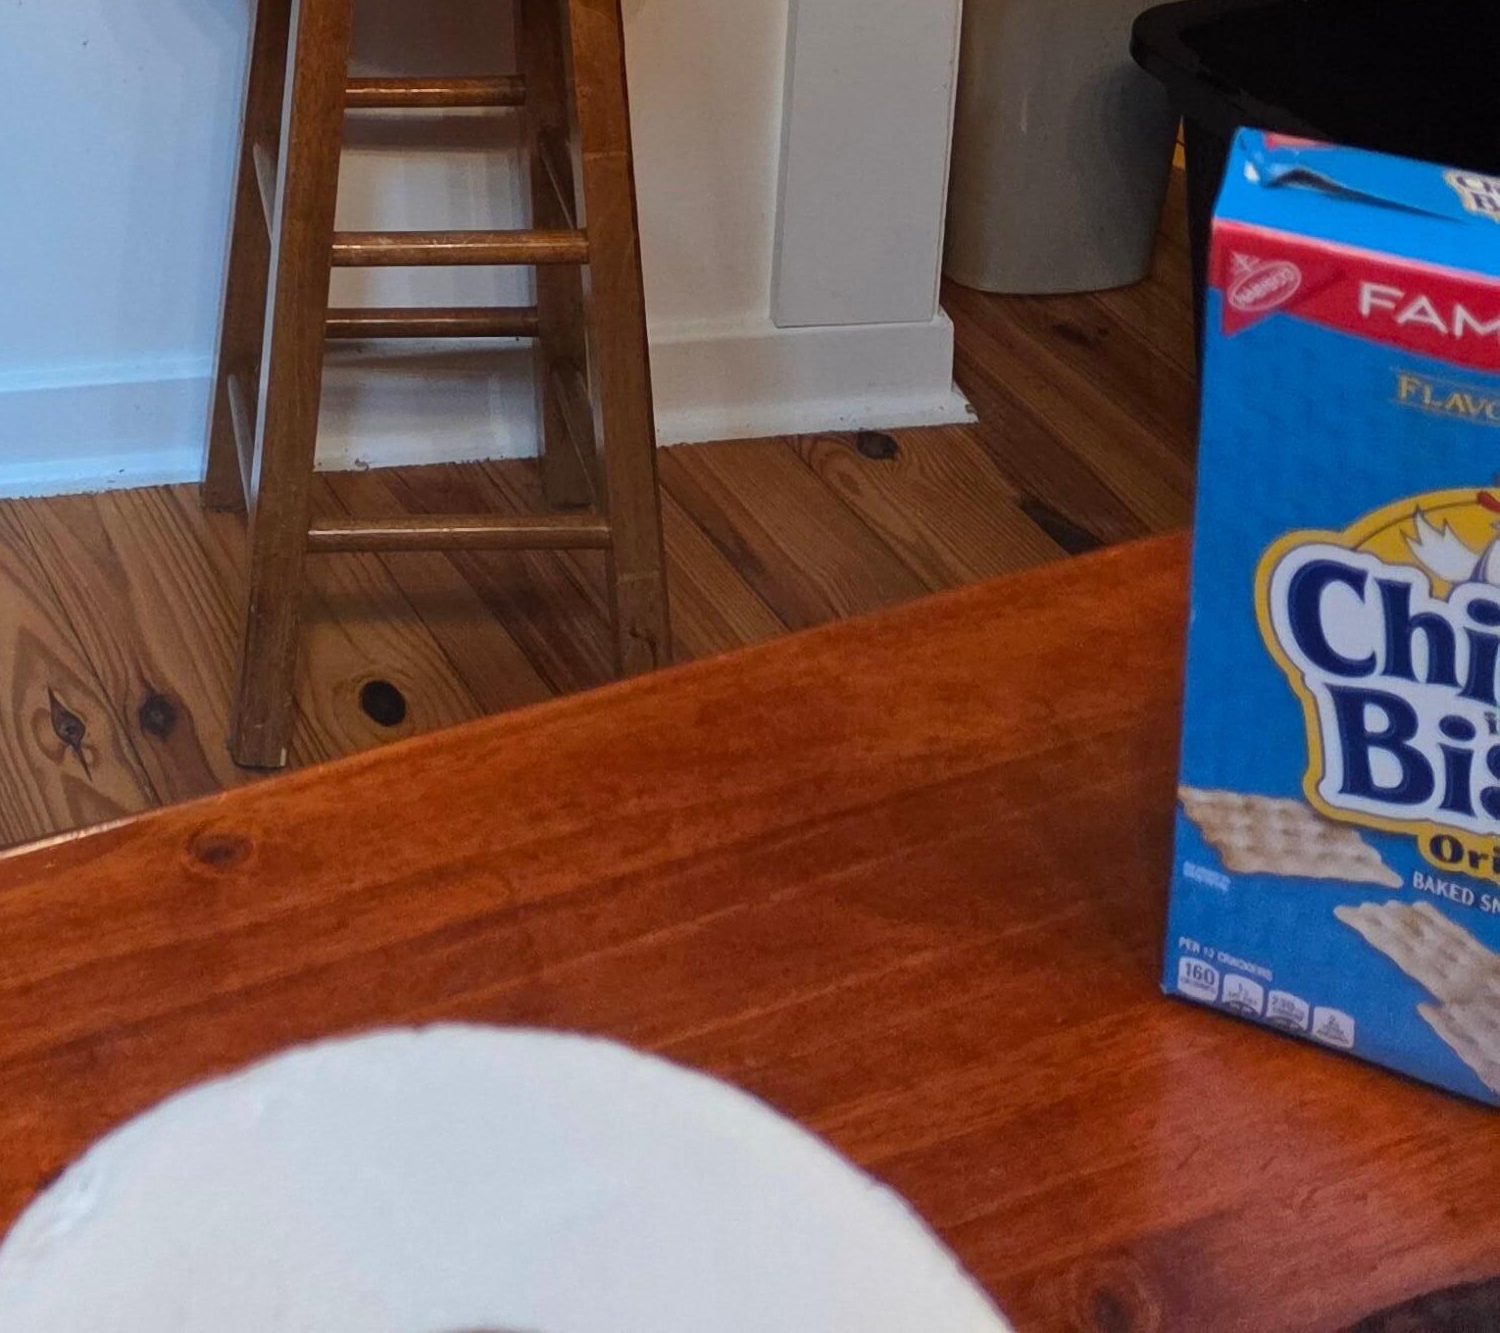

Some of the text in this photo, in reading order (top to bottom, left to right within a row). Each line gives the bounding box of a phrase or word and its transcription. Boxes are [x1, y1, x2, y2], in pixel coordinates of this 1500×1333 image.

[1413, 871, 1475, 906] BAKED
[1178, 937, 1201, 953] PER
[1185, 962, 1215, 986] 160
